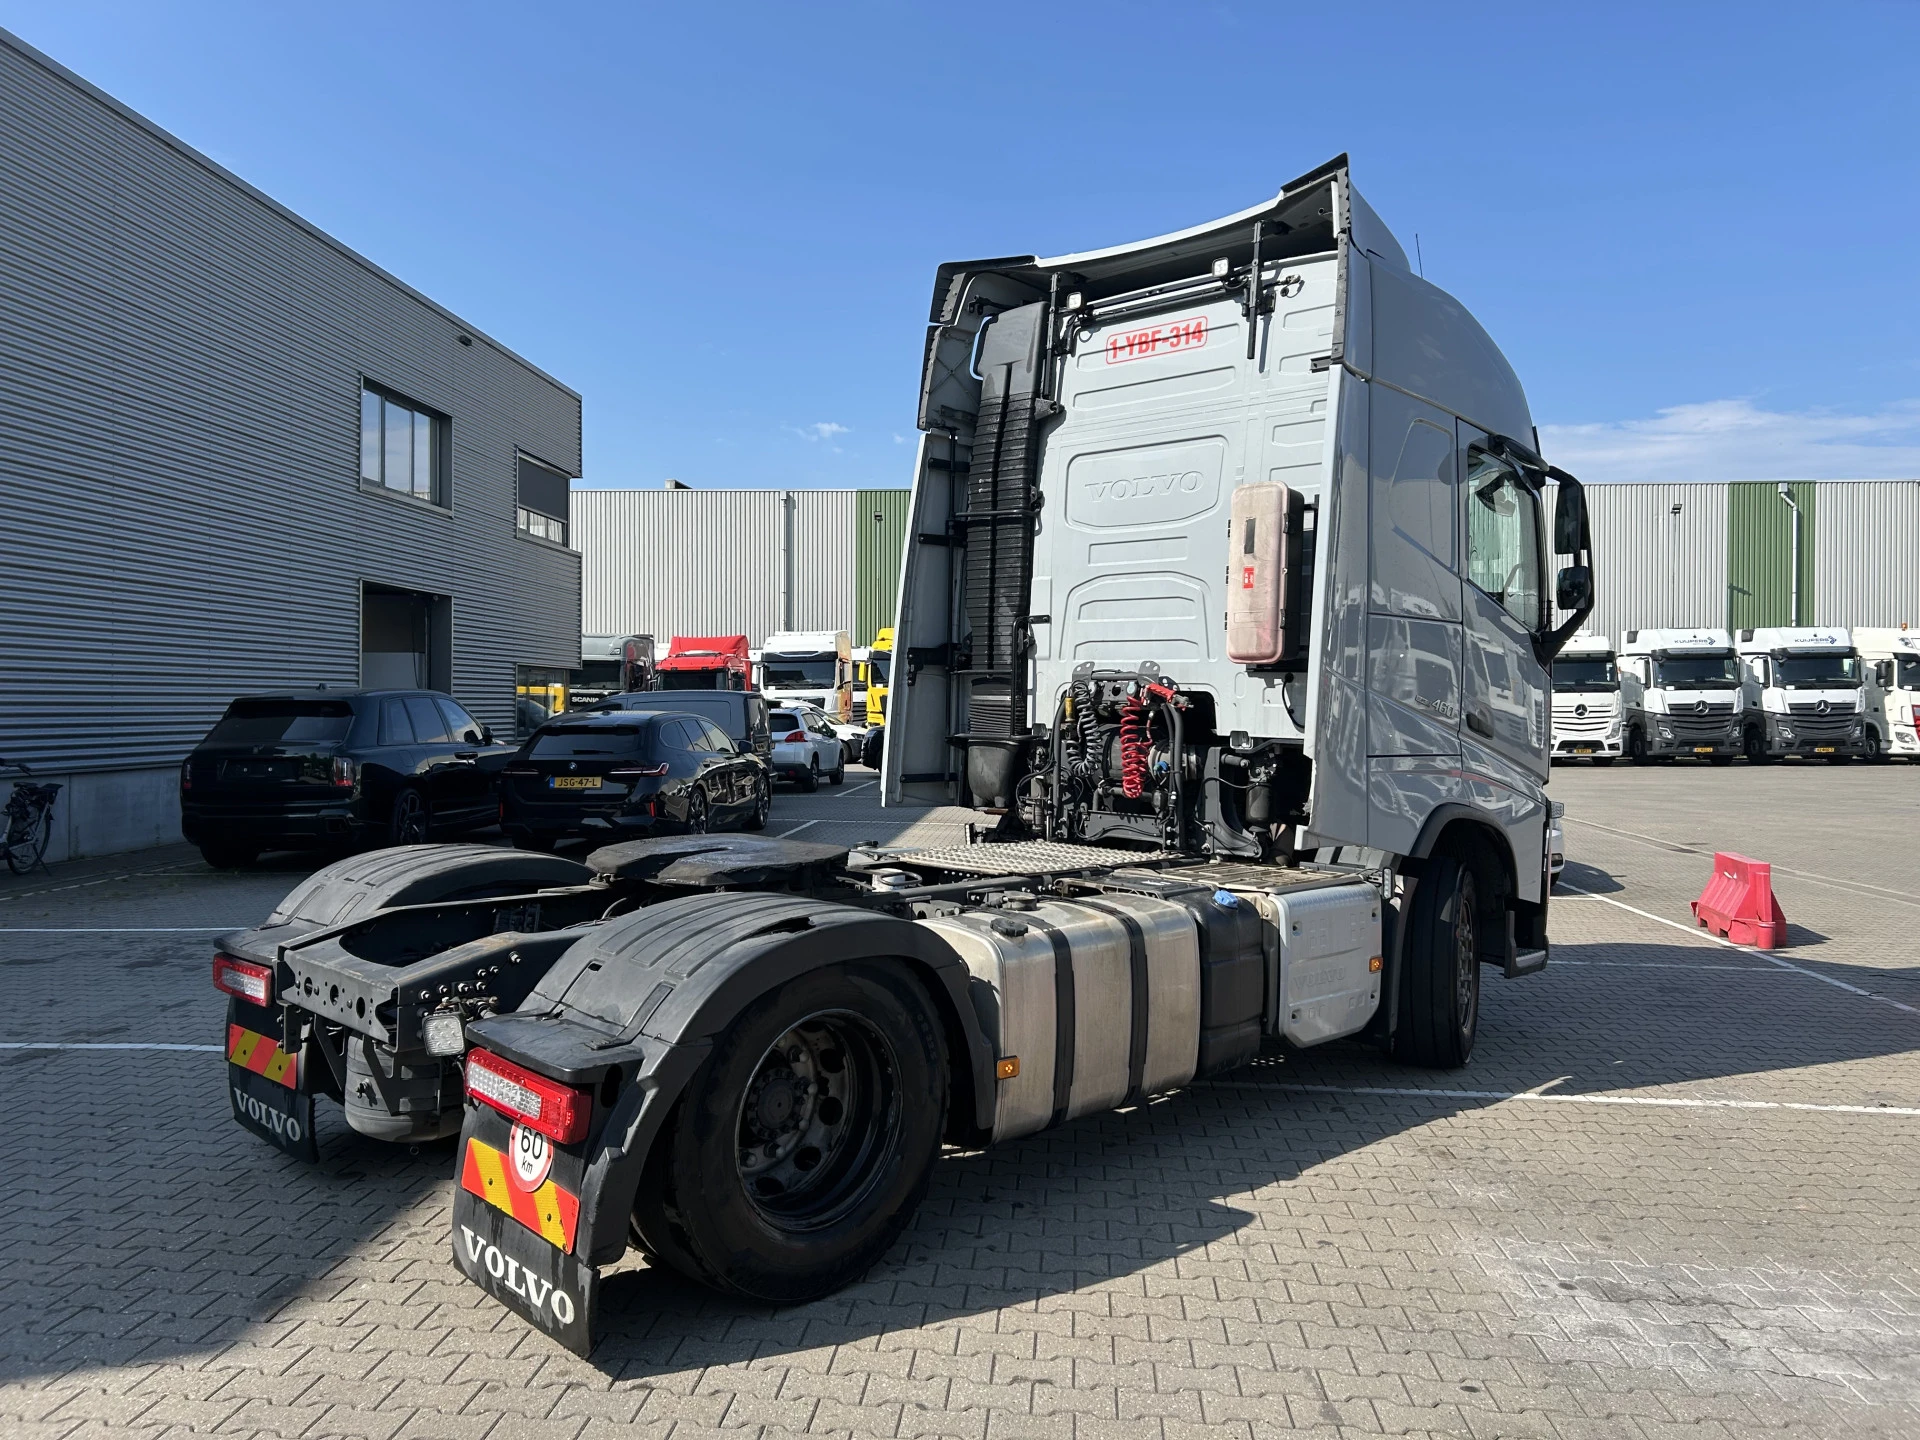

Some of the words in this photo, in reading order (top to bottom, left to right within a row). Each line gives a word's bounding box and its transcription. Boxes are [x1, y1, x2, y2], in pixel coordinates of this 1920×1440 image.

[1109, 321, 1204, 359] 1-YBF-314
[1084, 471, 1204, 502] VOLVO
[1431, 699, 1455, 719] 460
[558, 778, 598, 787] JSG-47-L
[234, 1087, 301, 1142] VOLVO
[521, 1126, 543, 1160] 60
[521, 1157, 533, 1175] km
[460, 1224, 575, 1325] VOLVO
